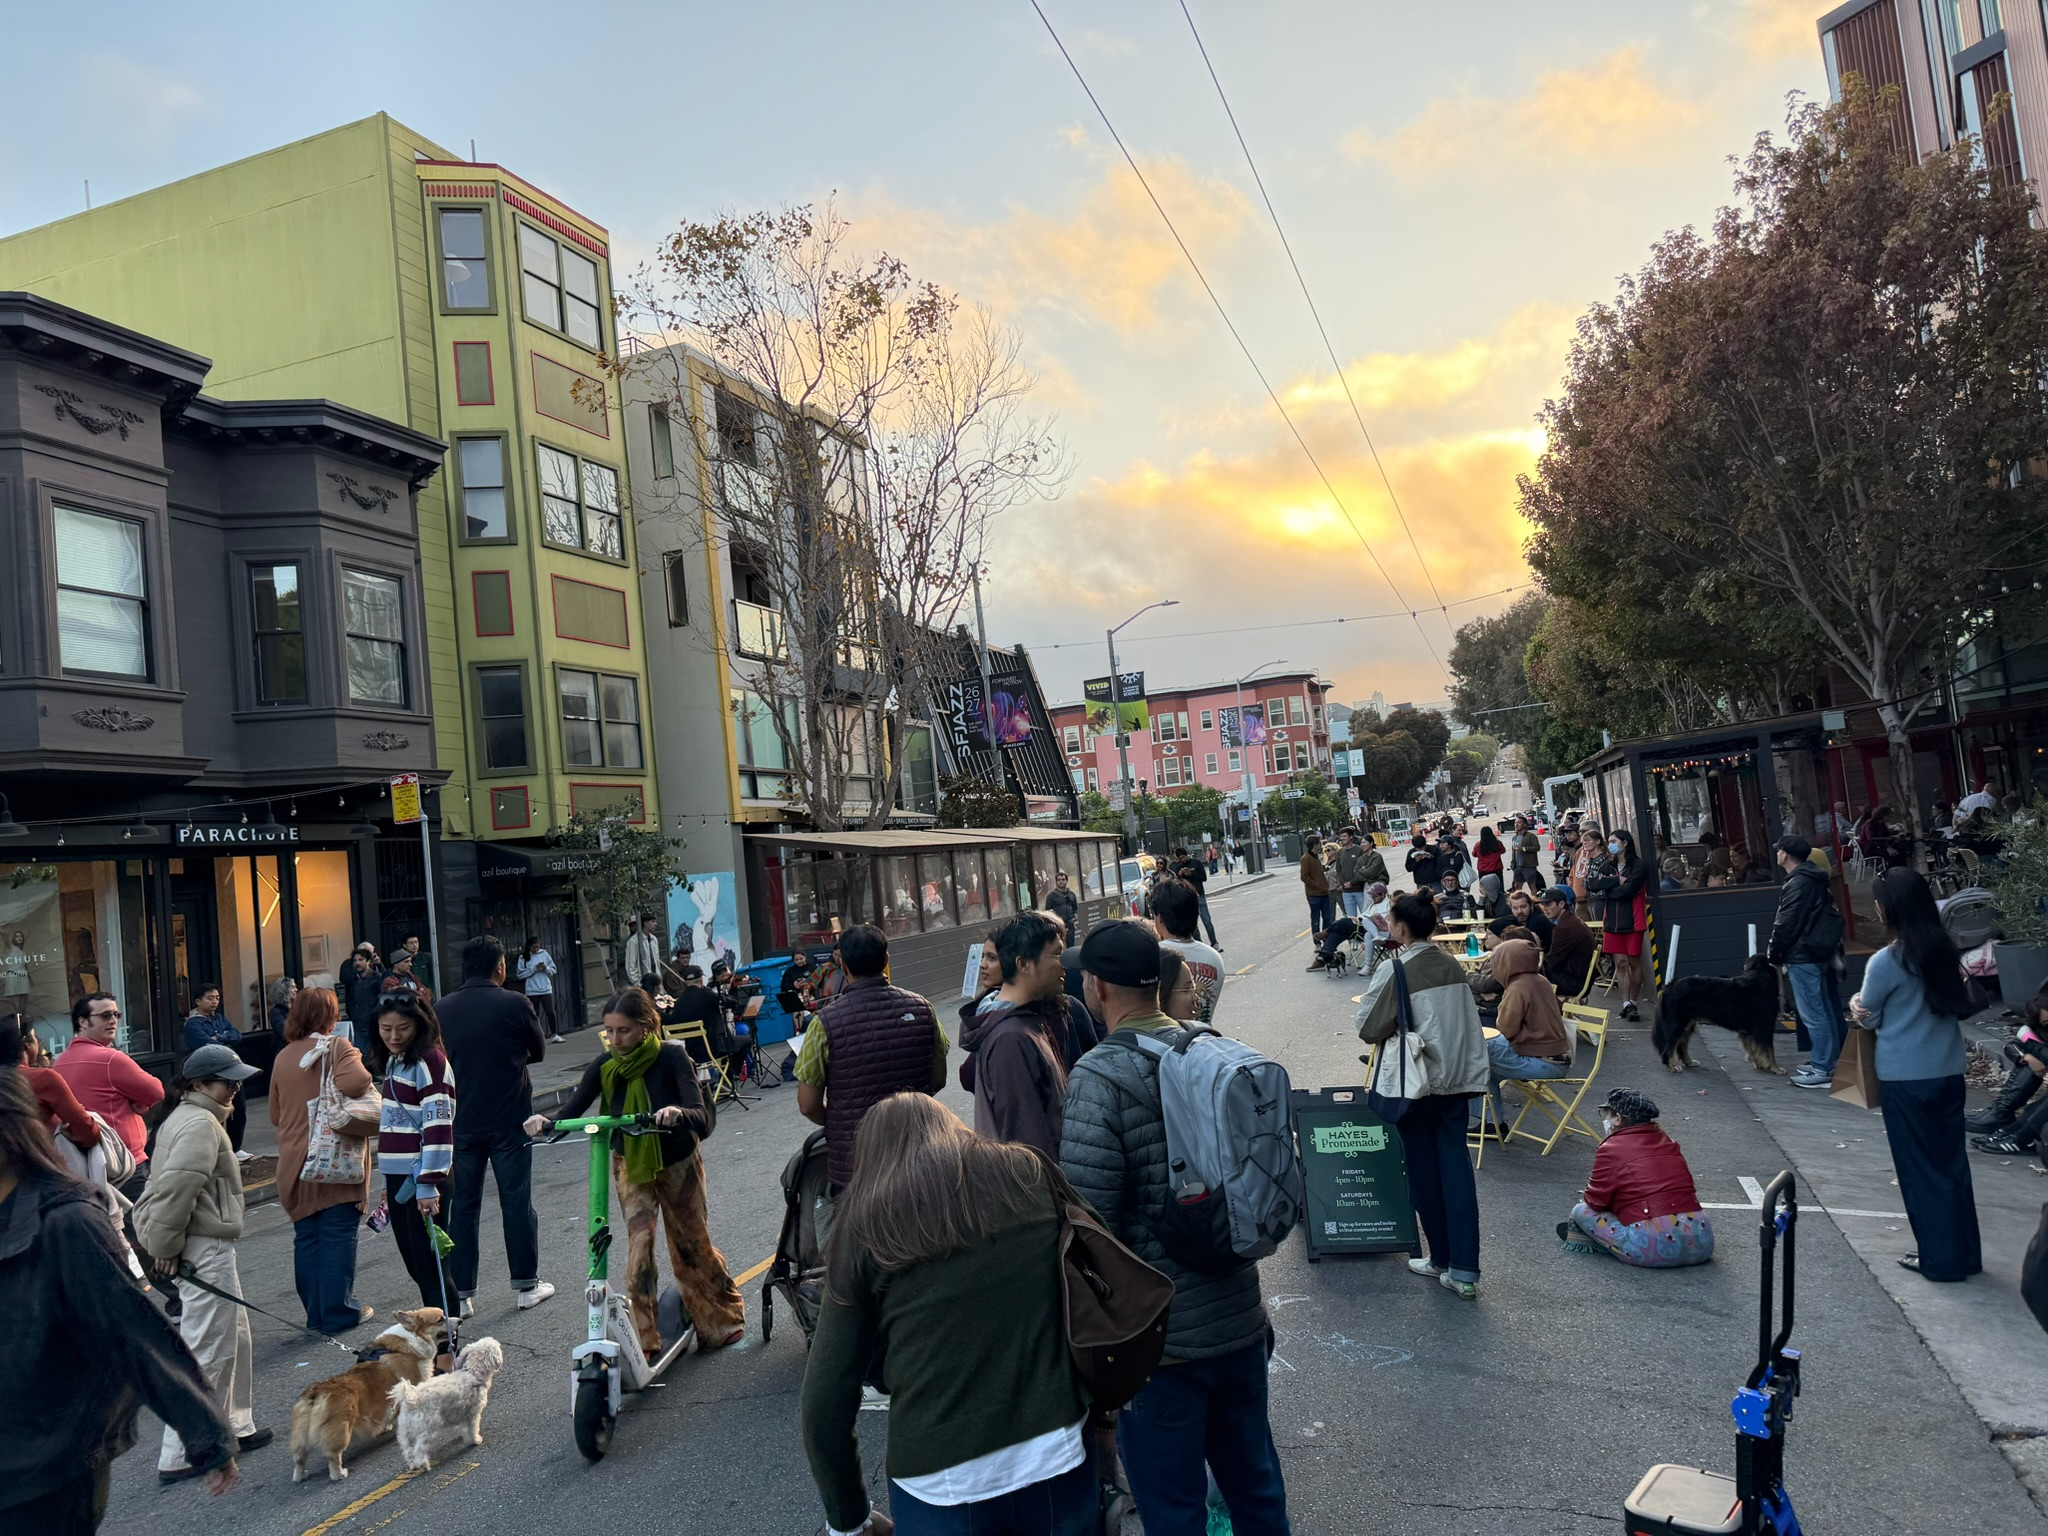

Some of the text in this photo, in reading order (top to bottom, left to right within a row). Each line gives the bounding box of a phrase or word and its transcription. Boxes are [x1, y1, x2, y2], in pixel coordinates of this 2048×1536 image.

[964, 686, 980, 699] 26
[1087, 682, 1109, 690] VIVID
[966, 698, 980, 712] 27
[949, 683, 971, 758] SFJAZZ
[1219, 709, 1231, 749] SFJAZZ
[551, 858, 565, 871] azil
[482, 866, 527, 877] azil boutique
[1329, 1131, 1369, 1139] HAYES
[1321, 1137, 1380, 1148] Promenade
